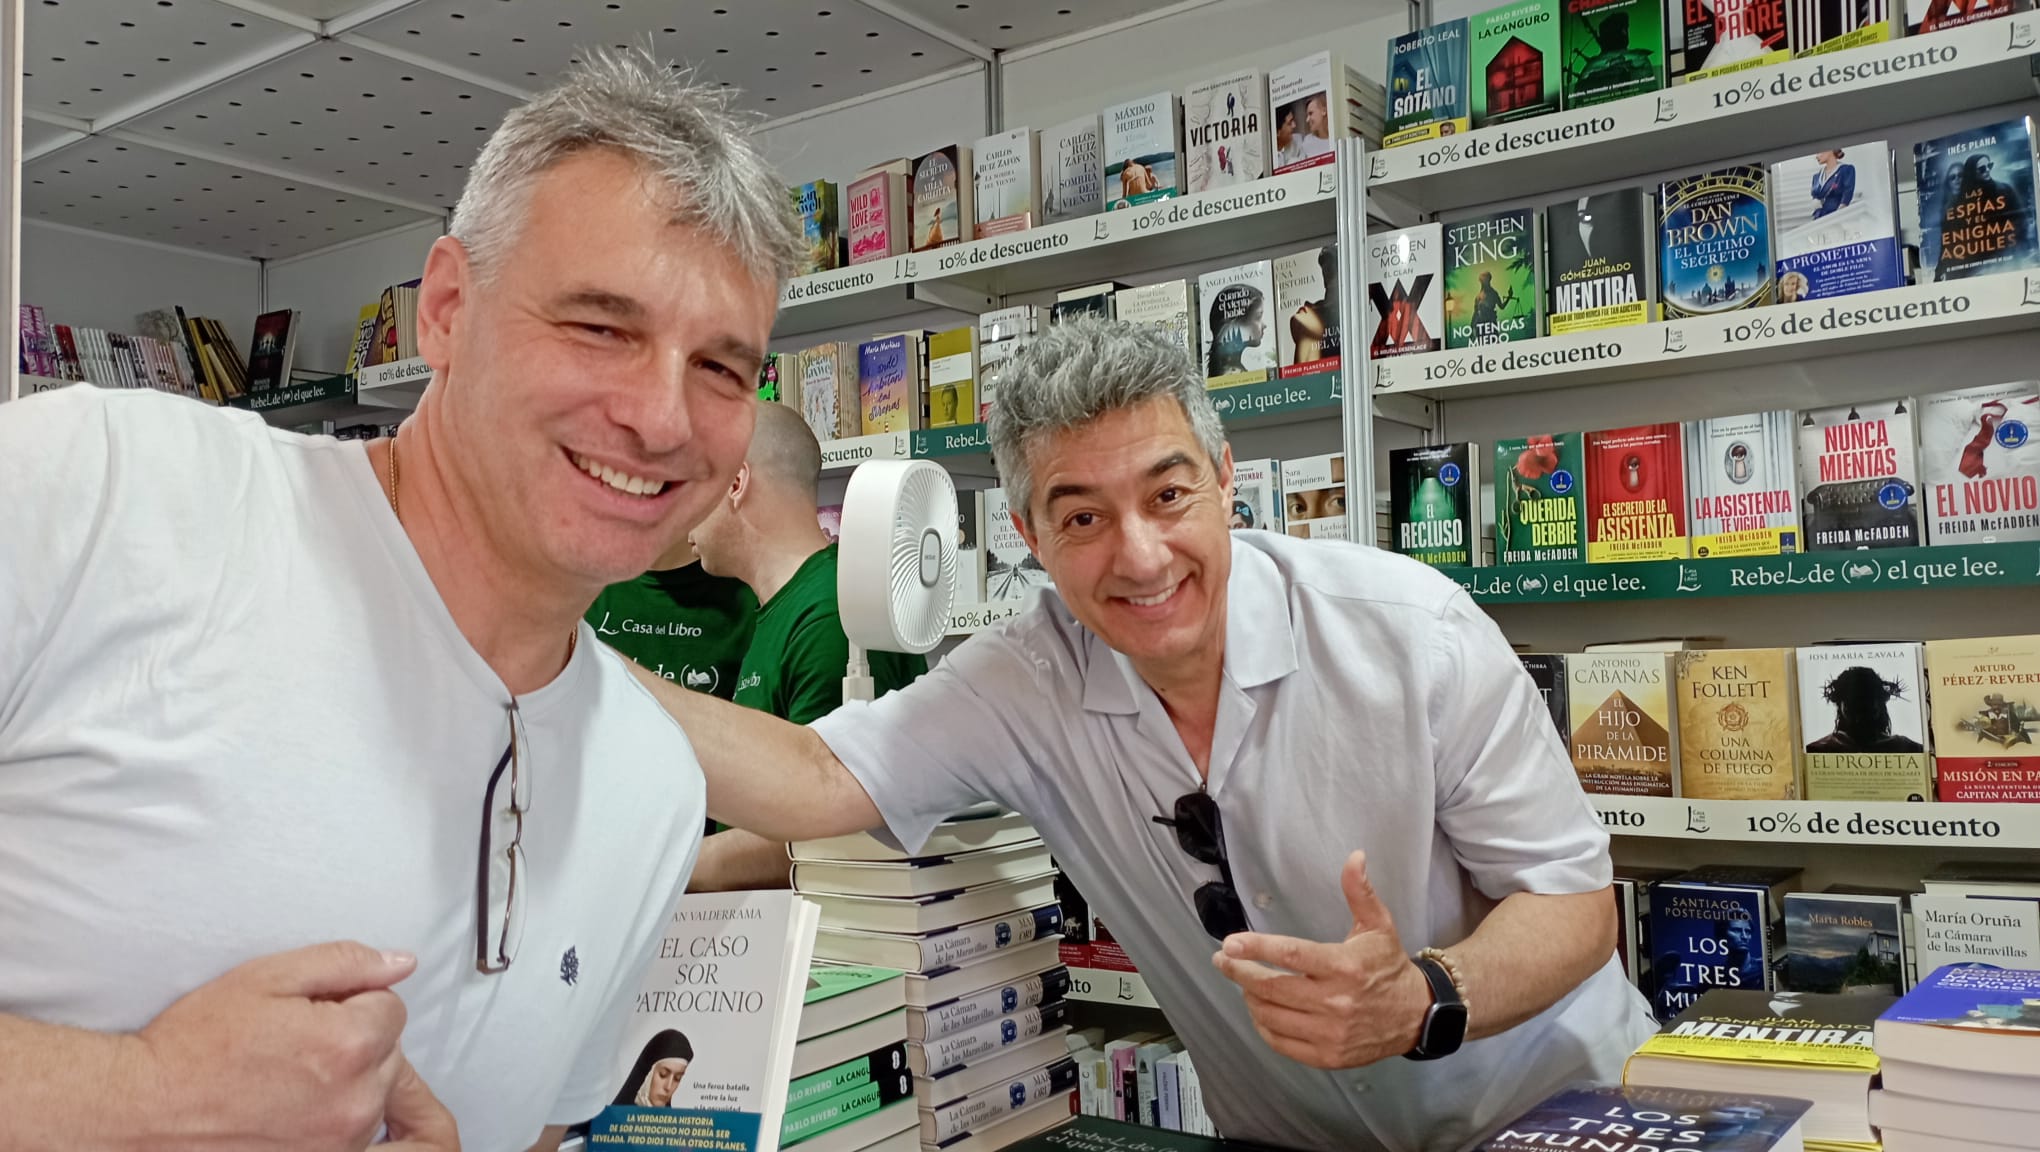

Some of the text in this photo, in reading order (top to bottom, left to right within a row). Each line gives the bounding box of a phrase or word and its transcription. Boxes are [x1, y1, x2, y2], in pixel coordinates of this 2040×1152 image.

[1485, 3, 1542, 25] PABLO RIVERO
[1715, 2, 1784, 44] PADRE
[1478, 12, 1550, 40] LA CANGURO
[1394, 28, 1460, 55] ROBERTO LEAL
[1416, 68, 1432, 91] EL
[1713, 46, 1958, 109] 10% de descuento
[1115, 102, 1155, 122] MÁXIMO
[1393, 84, 1457, 118] SÓTANO
[1116, 116, 1154, 134] HUERTA
[1191, 113, 1258, 147] VICTORIA
[1060, 134, 1096, 148] CARLOS
[1418, 117, 1615, 168] 10% de descuento
[986, 149, 1012, 161] CARLOS
[850, 194, 868, 212] WILD
[1132, 185, 1286, 232] 10% de descuento
[1692, 202, 1732, 224] DAN
[1946, 196, 2006, 220] ESPÍAS
[852, 211, 868, 229] LOVE
[1448, 216, 1524, 245] STEPHEN
[1667, 213, 1758, 248] BROWN
[1942, 220, 2014, 245] ENIGMA
[938, 232, 1068, 270] 10% de descuento
[1454, 237, 1518, 268] KING
[1674, 235, 1755, 259] EL ÚLTIMO
[1793, 242, 1877, 269] PROMETIDA
[1941, 234, 2016, 260] AQUILES
[1583, 256, 1606, 268] JUAN
[1681, 248, 1749, 270] SECRETO
[1560, 262, 1631, 282] GÓMEZ-JURADO
[788, 271, 874, 300] de descuento
[1556, 273, 1638, 314] MENTIRA
[1453, 317, 1526, 339] NO TENGAS
[1723, 294, 1970, 344] 10% de descuento
[1424, 342, 1622, 381] 10% de descuento
[301, 390, 312, 402] que
[1239, 388, 1311, 412] el que lee.
[1824, 420, 1888, 452] NUNCA
[1820, 448, 1896, 482] MIENTAS
[1603, 499, 1667, 517] EL SECRETO DE LA
[1696, 490, 1792, 520] LA ASISTENTA
[1936, 476, 2038, 518] EL NOVIO
[1426, 504, 1434, 518] EL
[1520, 496, 1576, 525] QUERIDA
[1400, 519, 1462, 548] RECLUSO
[1532, 521, 1577, 546] DEBBIE
[1597, 514, 1676, 542] ASISTENTA
[1816, 525, 1910, 546] FREIDA McFADDEN
[1939, 514, 2040, 535] FREIDA McFADDEN
[1428, 551, 1466, 564] McFADDEN
[1504, 548, 1578, 562] FREIDA McFADDEN
[1888, 560, 1906, 579] el
[1914, 564, 1957, 585] que
[1962, 558, 2005, 578] lee.
[1553, 574, 1575, 593] el
[1574, 580, 1607, 598] que
[1612, 572, 1646, 592] lee.
[622, 619, 652, 634] Casa
[656, 626, 666, 634] del
[668, 622, 702, 637] Libro
[1591, 658, 1641, 668] ANTONIO
[1712, 665, 1748, 680] KEN
[1973, 664, 2015, 672] ARTURO
[1574, 668, 1660, 684] CABANAS
[1692, 681, 1771, 700] FOLLETT
[1614, 700, 1623, 708] EL
[1598, 710, 1641, 730] HIJO
[1606, 732, 1634, 741] DE LA
[1720, 737, 1750, 748] UNA
[1577, 743, 1667, 762] PIRÁMIDE
[1700, 750, 1774, 761] COLUMNA
[1812, 755, 1918, 768] EL PROFETA
[1703, 763, 1773, 774] DE FUEGO
[1944, 769, 1998, 782] MISIÓN
[2002, 771, 2020, 782] EN
[1748, 812, 2000, 838] 10% de descuento
[1665, 907, 1752, 921] POSTEGUILLO
[1672, 896, 1740, 911] SANTIAGO
[690, 908, 762, 922] VALDERRAMA
[1808, 912, 1872, 928] Marta Robles
[1925, 910, 2022, 928] María Oruña
[1688, 936, 1729, 956] LOS
[1926, 928, 1992, 942] La Cámara
[660, 936, 748, 958] EL CASO
[1927, 941, 2028, 958] de las Maravillas
[675, 964, 718, 984] SOR
[1680, 963, 1741, 986] TRES
[636, 991, 763, 1014] ATROCINIO
[940, 1002, 976, 1020] La Cámara
[941, 1010, 994, 1032] de las Maravillas
[1672, 1021, 1874, 1046] MENTIRA
[627, 1114, 713, 1126] LA VERDADERA HISTORIA
[1604, 1107, 1700, 1126] LOS
[1567, 1116, 1706, 1144] TRES
